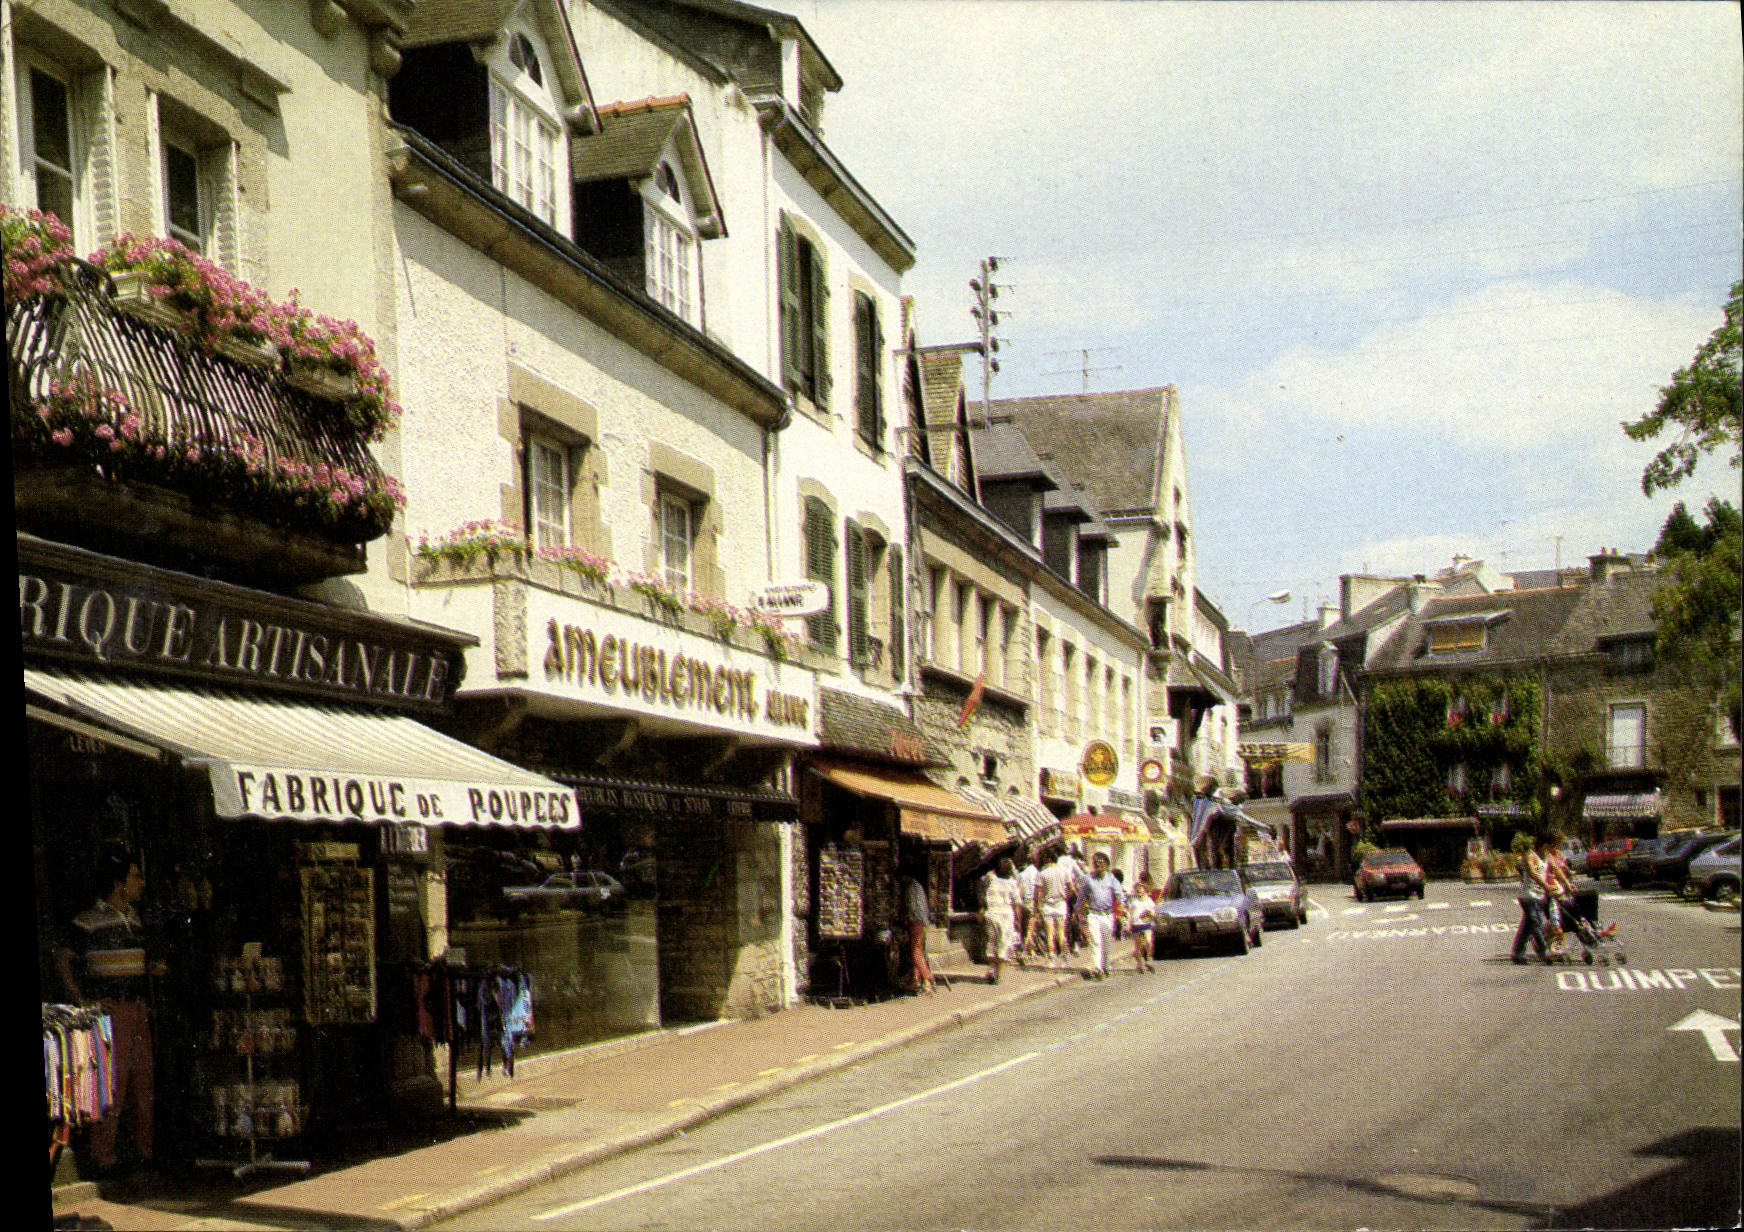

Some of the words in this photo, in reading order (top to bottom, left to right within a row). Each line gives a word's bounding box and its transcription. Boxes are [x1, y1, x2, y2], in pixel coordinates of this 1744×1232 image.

[203, 615, 449, 702] ARTISANALE
[237, 770, 406, 820] FABRIQUE
[416, 793, 443, 818] DE
[468, 787, 572, 823] POUPEES
[1556, 967, 1741, 991] QUIMPE
